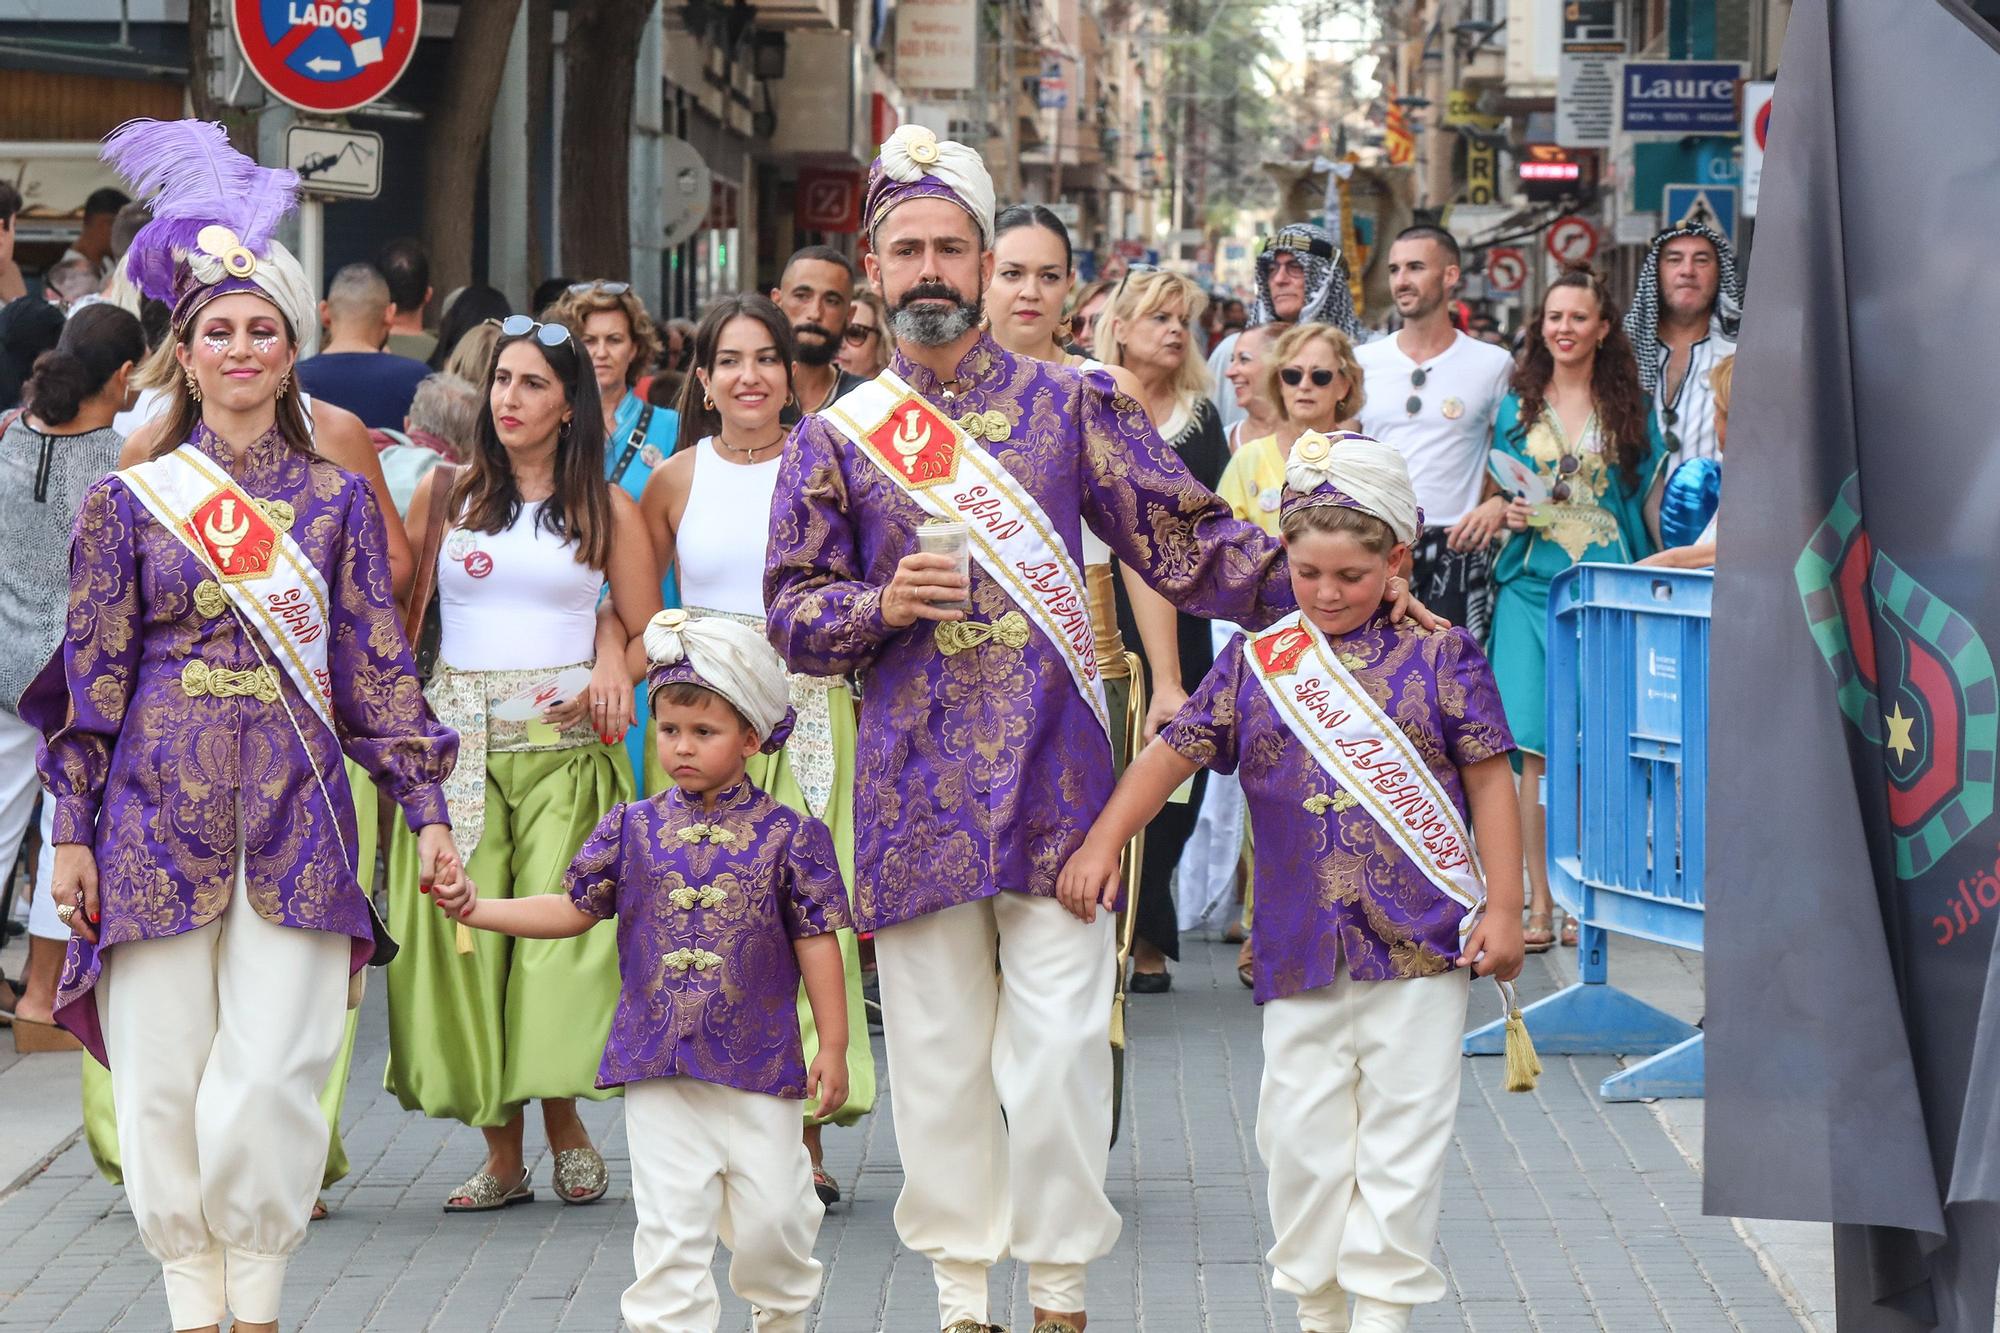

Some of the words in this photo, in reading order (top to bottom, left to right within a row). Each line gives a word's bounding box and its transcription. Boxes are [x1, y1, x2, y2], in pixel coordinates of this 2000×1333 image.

[288, 2, 368, 31] LADOS
[1631, 74, 1733, 100] Laure
[953, 485, 1025, 540] GRAN
[268, 588, 323, 644] GRAN
[1294, 678, 1352, 729] GRAN
